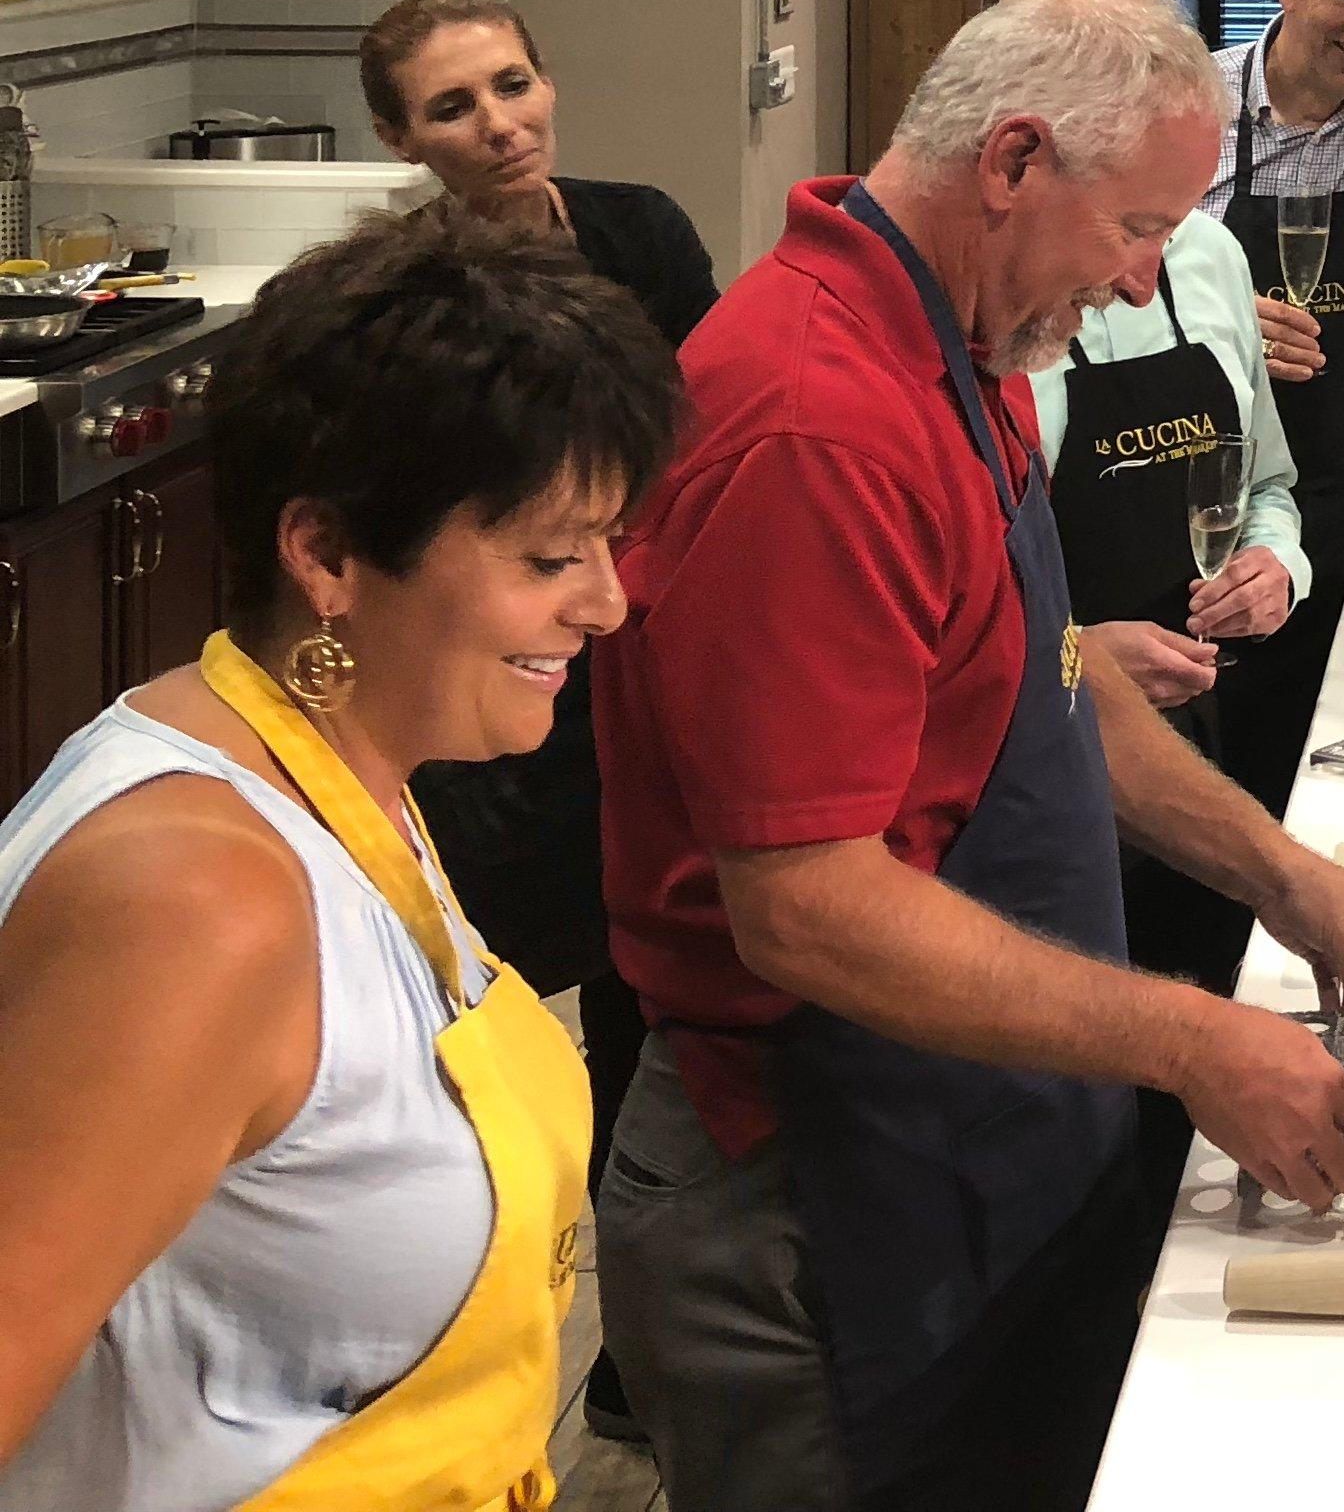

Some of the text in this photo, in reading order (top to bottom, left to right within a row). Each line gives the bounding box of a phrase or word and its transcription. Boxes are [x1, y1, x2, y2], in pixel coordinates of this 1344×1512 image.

[1095, 412, 1217, 456] LA CUCINA
[1155, 451, 1167, 464] AT
